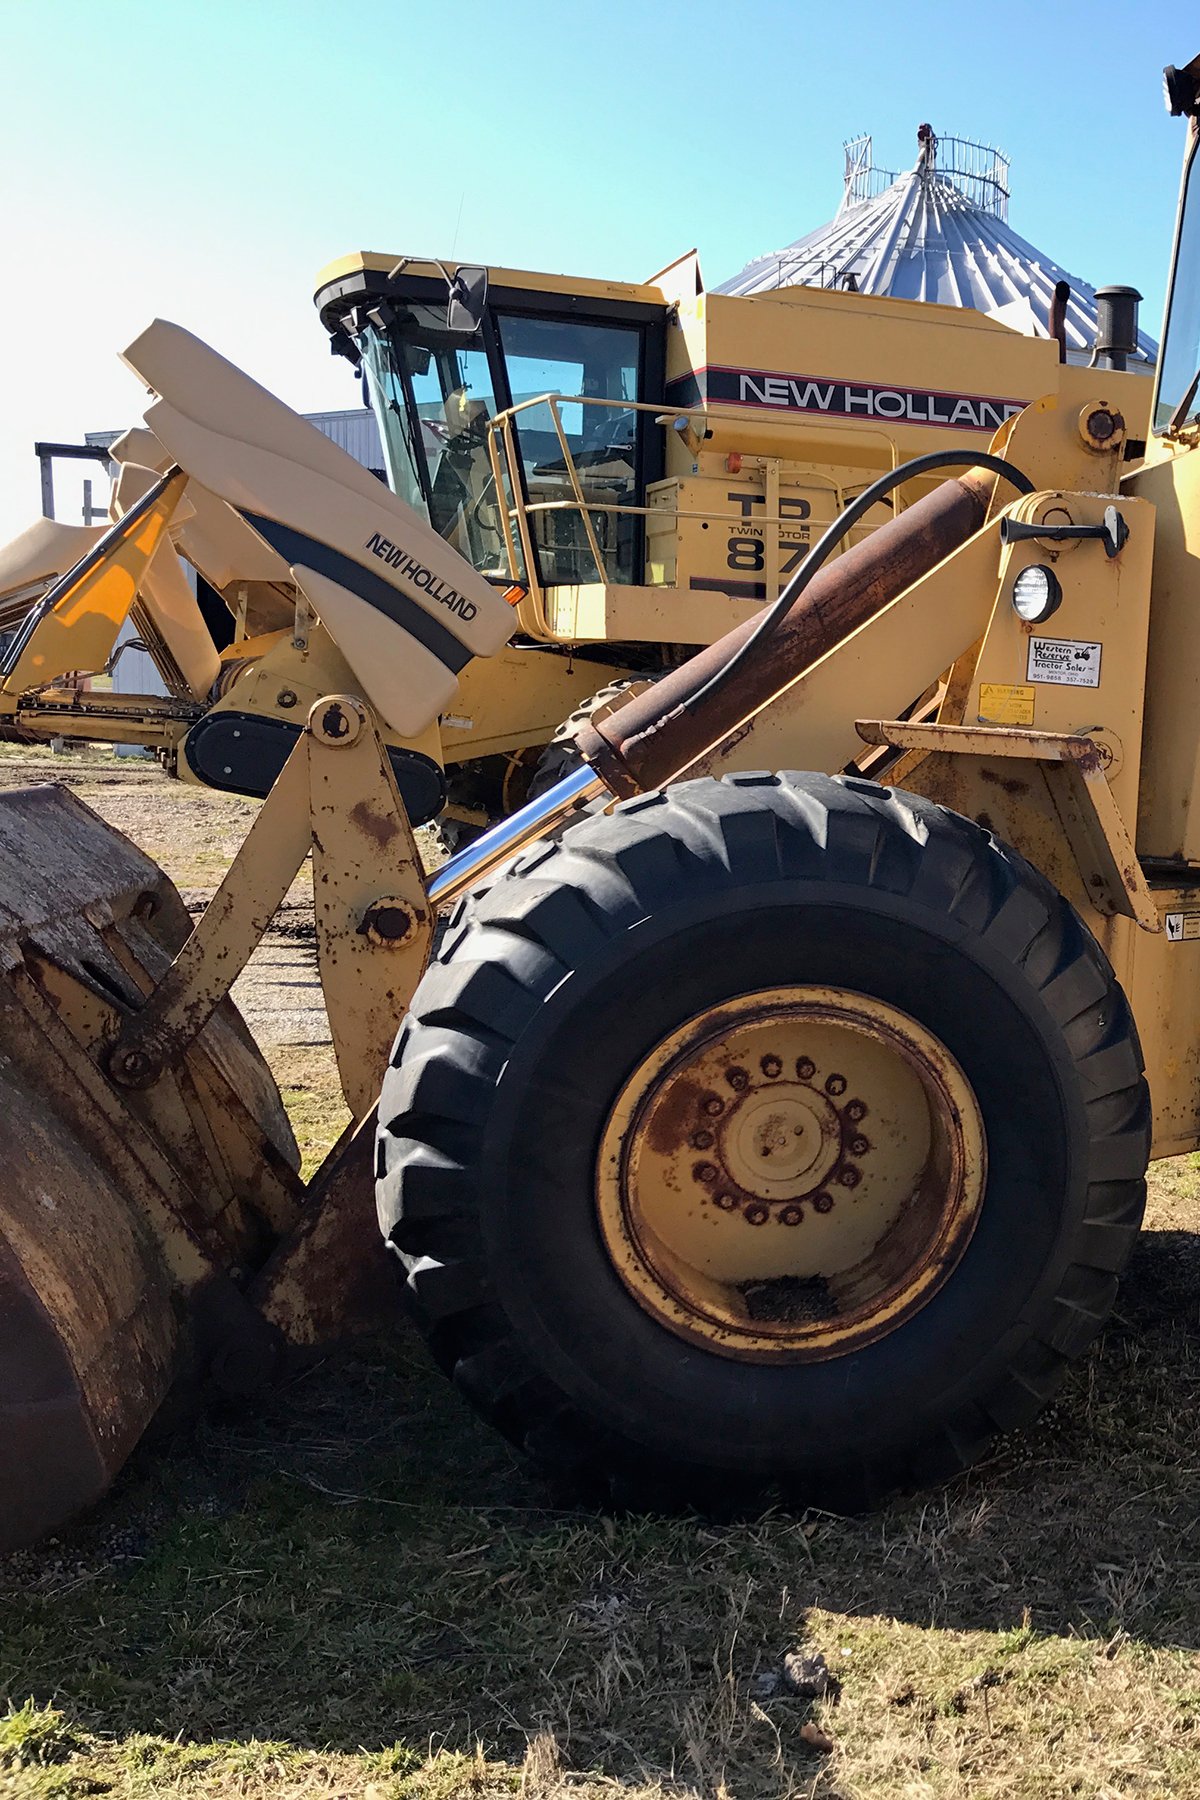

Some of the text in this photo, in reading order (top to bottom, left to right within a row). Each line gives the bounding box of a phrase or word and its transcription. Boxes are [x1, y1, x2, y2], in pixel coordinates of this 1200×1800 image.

[739, 374, 835, 410] NEW
[728, 526, 810, 540] TWIN OTOR
[727, 536, 810, 574] 87
[366, 532, 478, 622] NEW HOLLAND
[1033, 641, 1073, 654] Western
[1035, 649, 1071, 662] Reserve
[1033, 658, 1063, 670] Tractor
[1066, 662, 1087, 672] Sales
